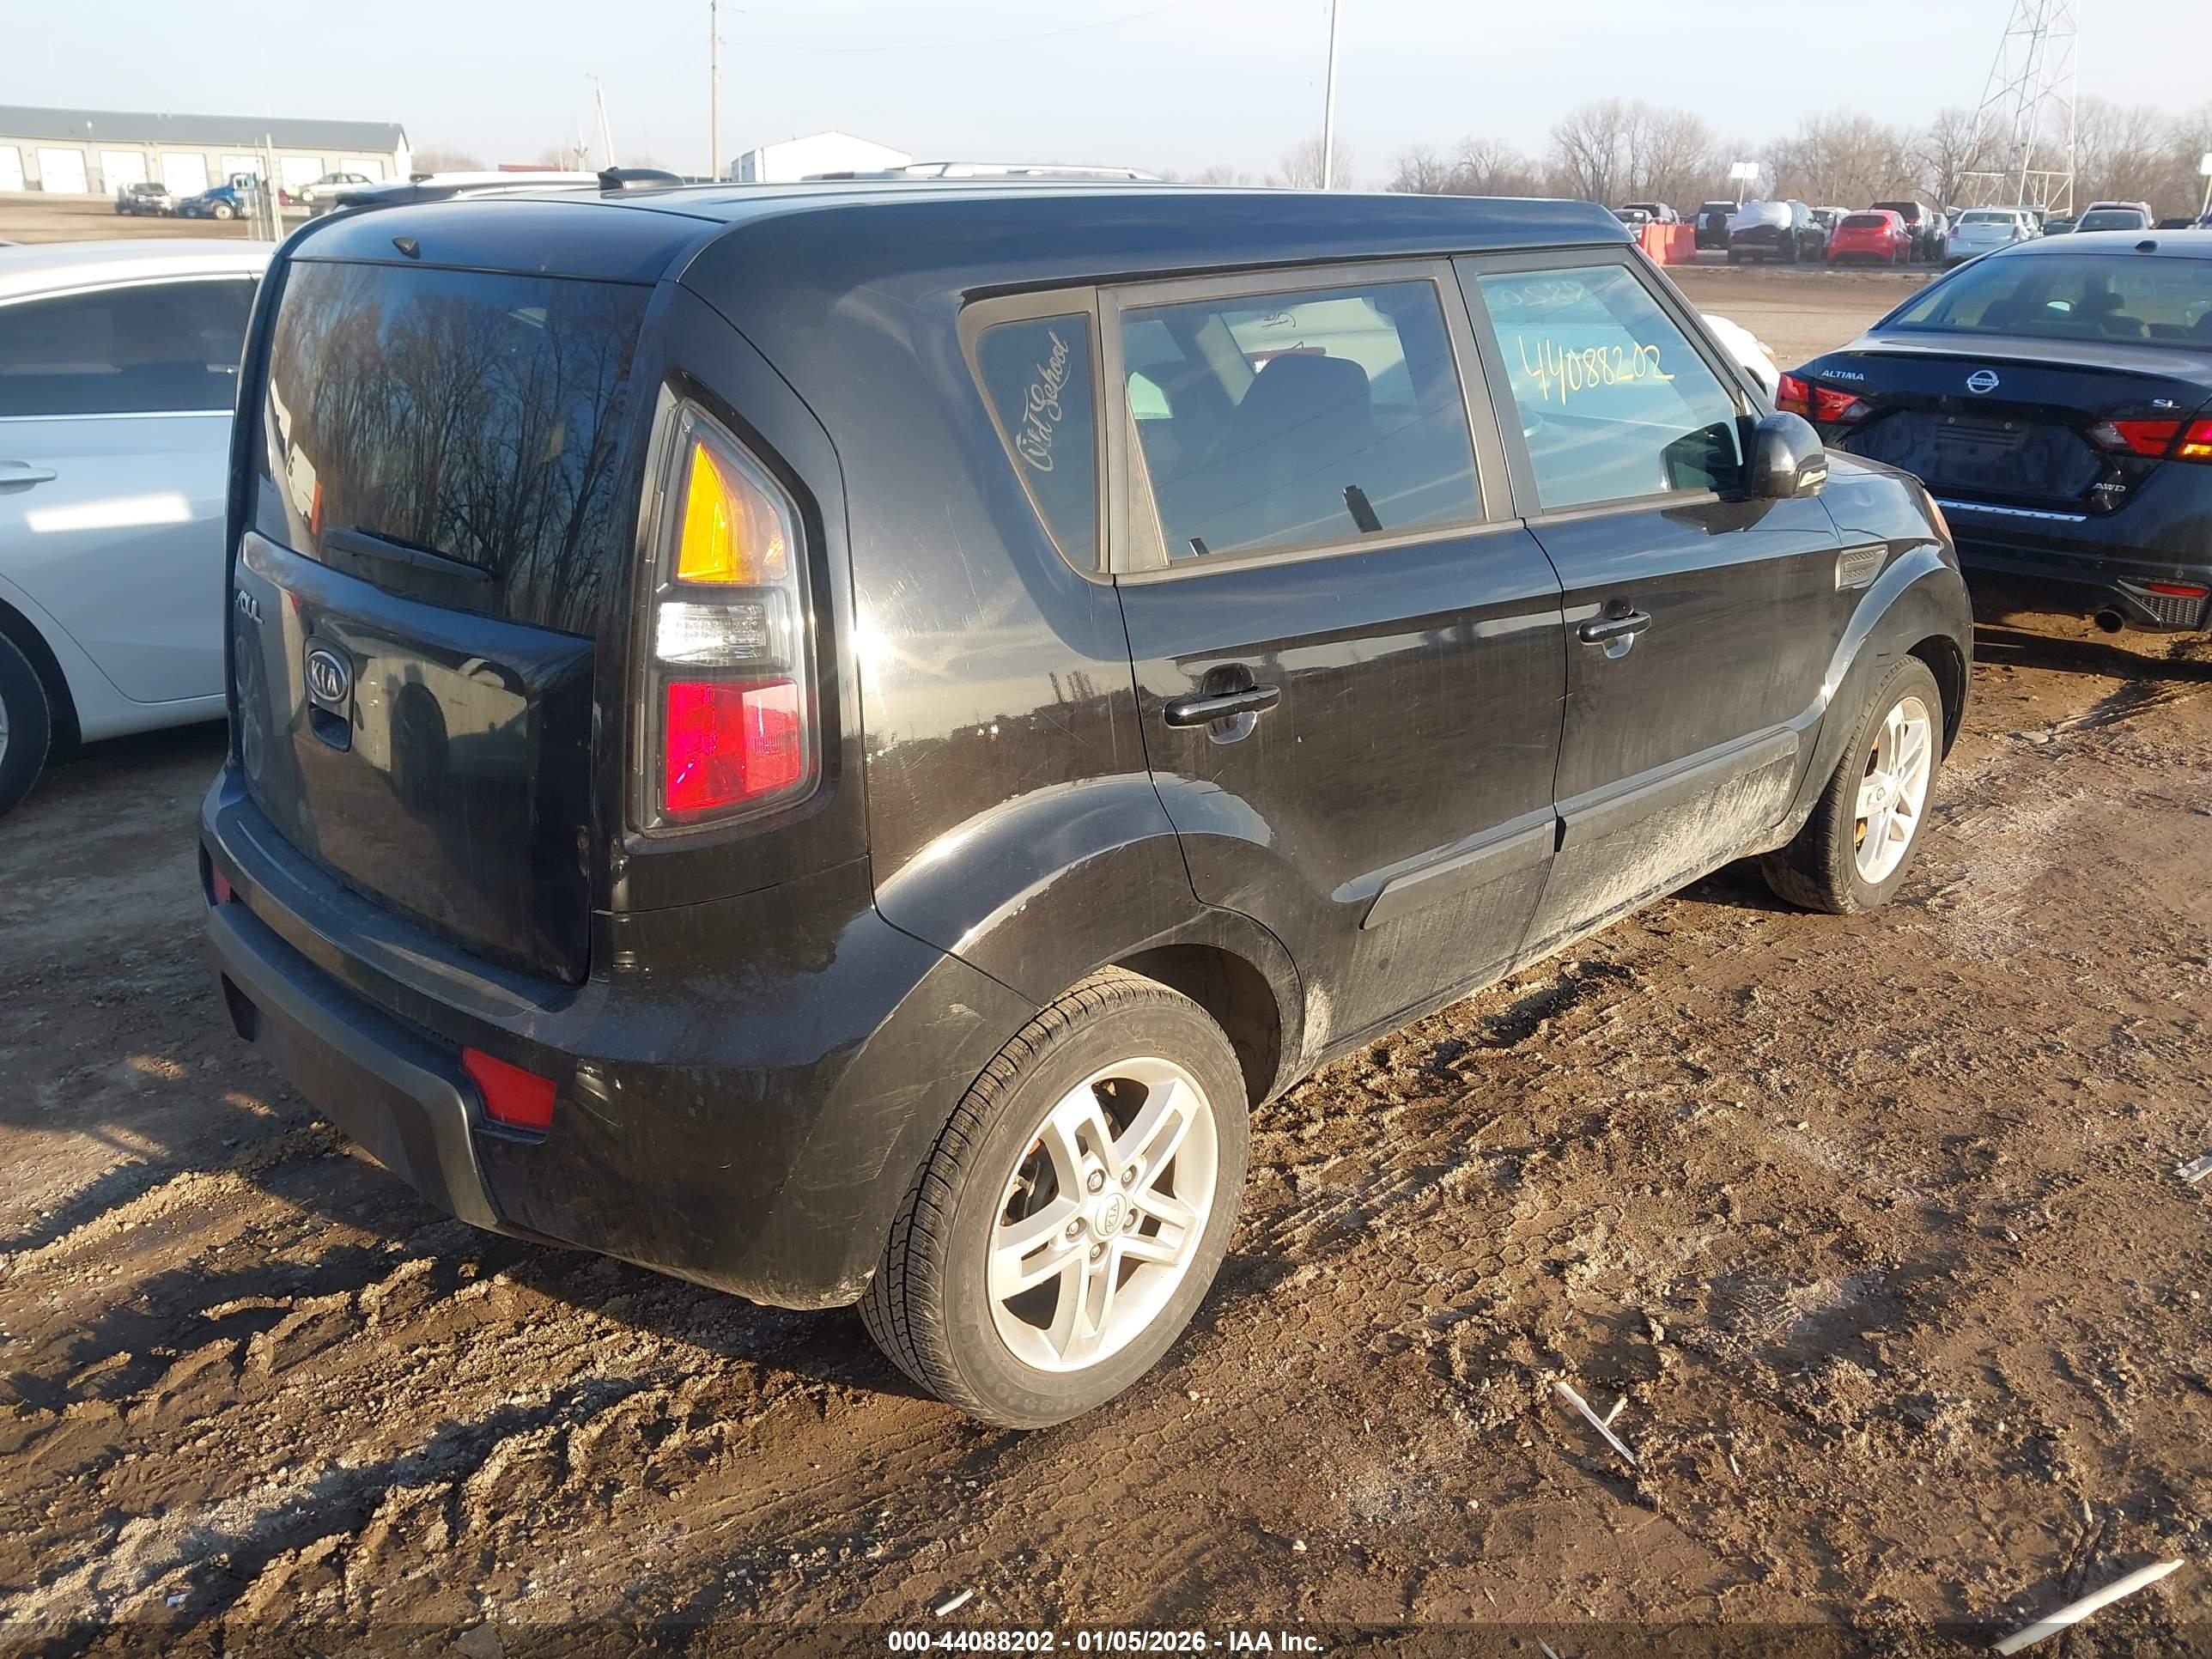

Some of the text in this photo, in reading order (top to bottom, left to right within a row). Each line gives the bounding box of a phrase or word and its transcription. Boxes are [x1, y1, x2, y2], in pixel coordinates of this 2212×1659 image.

[1518, 335, 1674, 405] 44088202
[1820, 369, 1864, 381] ALTIMA
[2092, 483, 2126, 492] AWD
[311, 660, 340, 696] KIA
